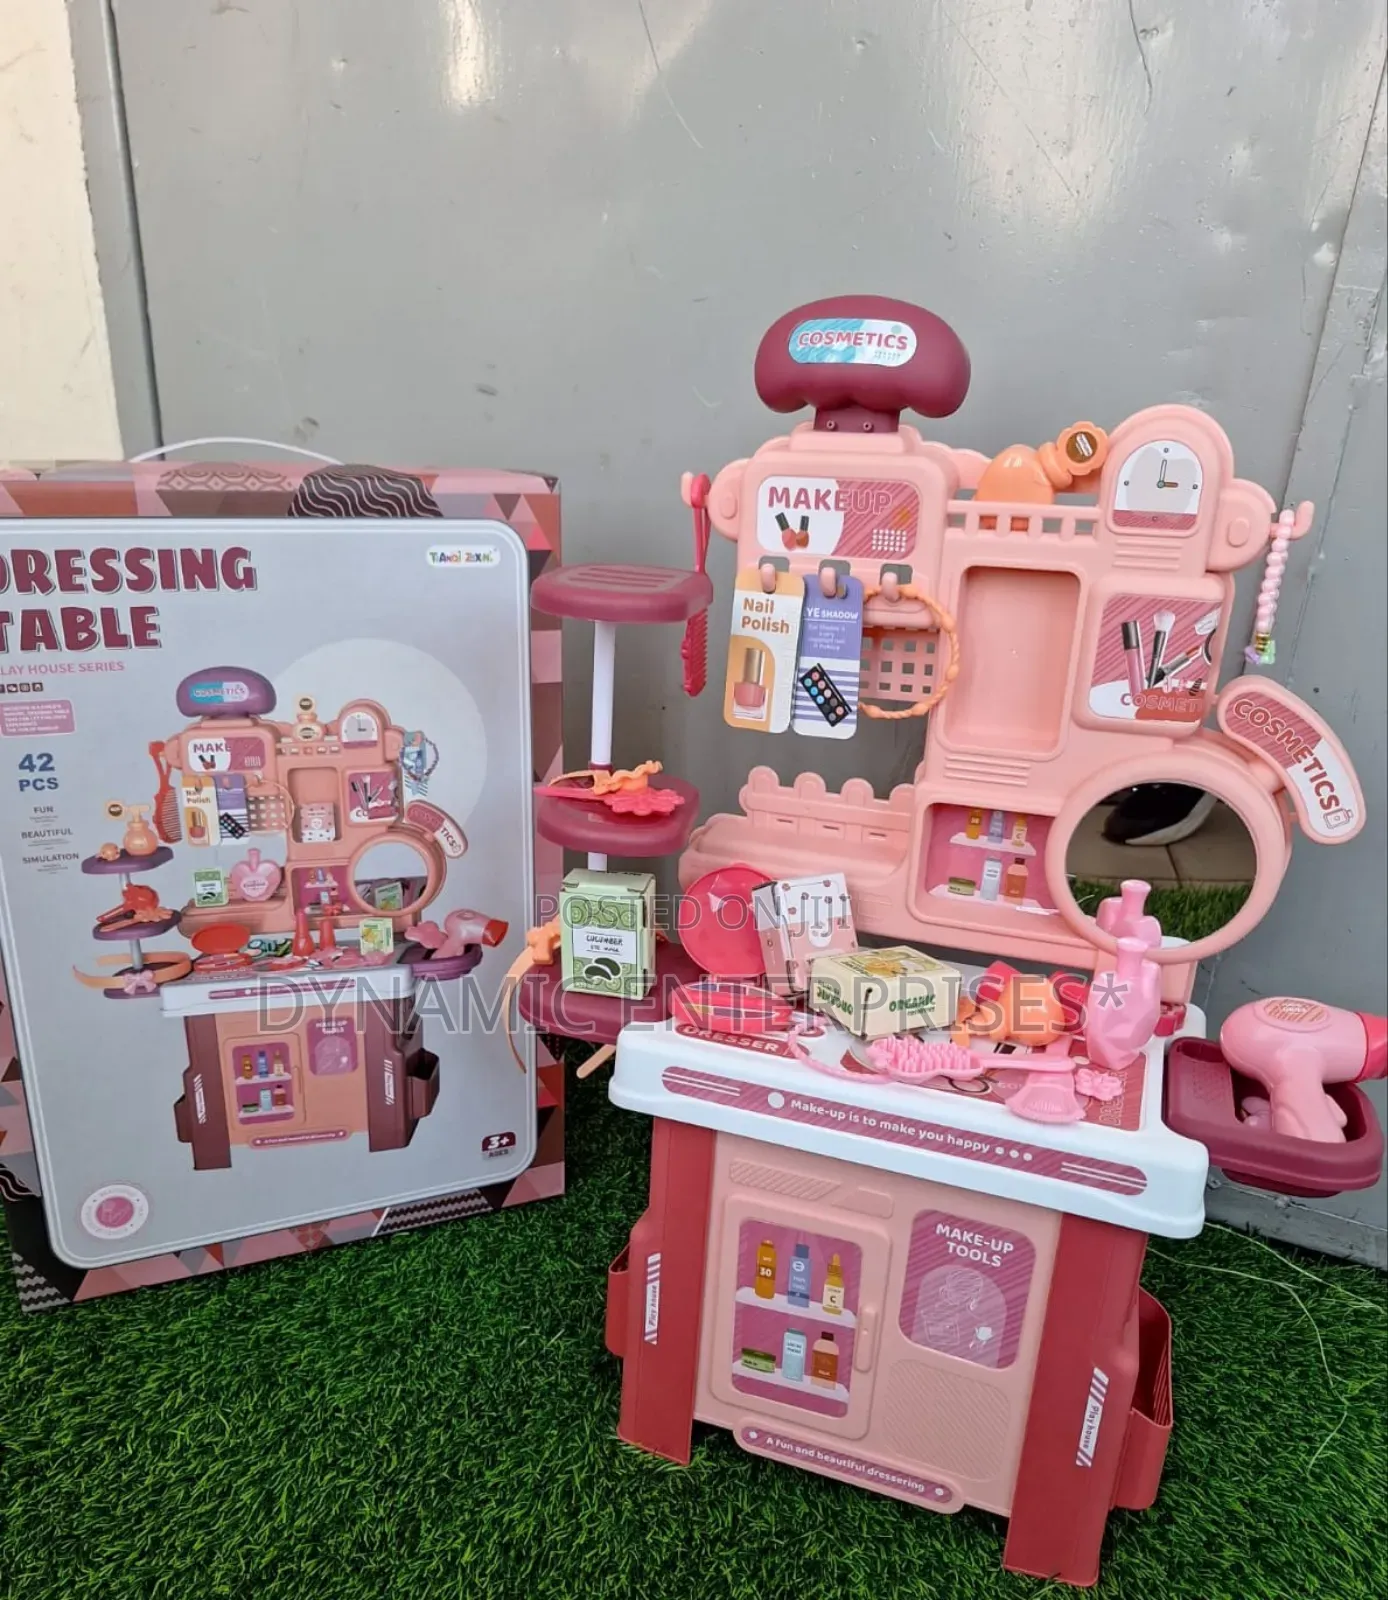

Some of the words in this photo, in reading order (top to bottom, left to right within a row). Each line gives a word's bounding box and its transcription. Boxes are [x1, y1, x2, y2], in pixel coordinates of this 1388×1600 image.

[798, 331, 908, 350] COSMETICS
[768, 486, 893, 516] MAKEUP
[0, 546, 258, 595] RESSING
[743, 597, 775, 614] Nail
[806, 607, 820, 618] YE
[821, 610, 859, 619] SHADOW
[741, 616, 790, 634] Polish
[0, 664, 24, 676] LAY
[28, 662, 75, 675] HOUSE
[78, 660, 125, 673] SERIES
[18, 752, 55, 773] 42
[1233, 699, 1342, 812] COSMETICS
[18, 777, 59, 792] PCS
[33, 806, 54, 814] FUN
[21, 828, 73, 839] BEAUTIFUL
[22, 853, 79, 864] SIMULATION
[681, 1025, 779, 1053] DRESSER
[791, 1099, 846, 1121] Make-up
[849, 1110, 860, 1123] is
[862, 1114, 877, 1127] to
[879, 1121, 916, 1136] make
[918, 1129, 944, 1142] you
[947, 1134, 991, 1154] happy
[487, 1135, 510, 1149] 3+
[935, 1222, 1015, 1255] MAKE-UP
[946, 1241, 1002, 1268] TOOLS
[760, 1266, 773, 1277] 30
[829, 1295, 837, 1304] C
[766, 1437, 774, 1445] A
[775, 1439, 794, 1451] fun
[795, 1445, 816, 1458] and
[817, 1451, 867, 1473] beautiful
[866, 1466, 925, 1492] dressering
